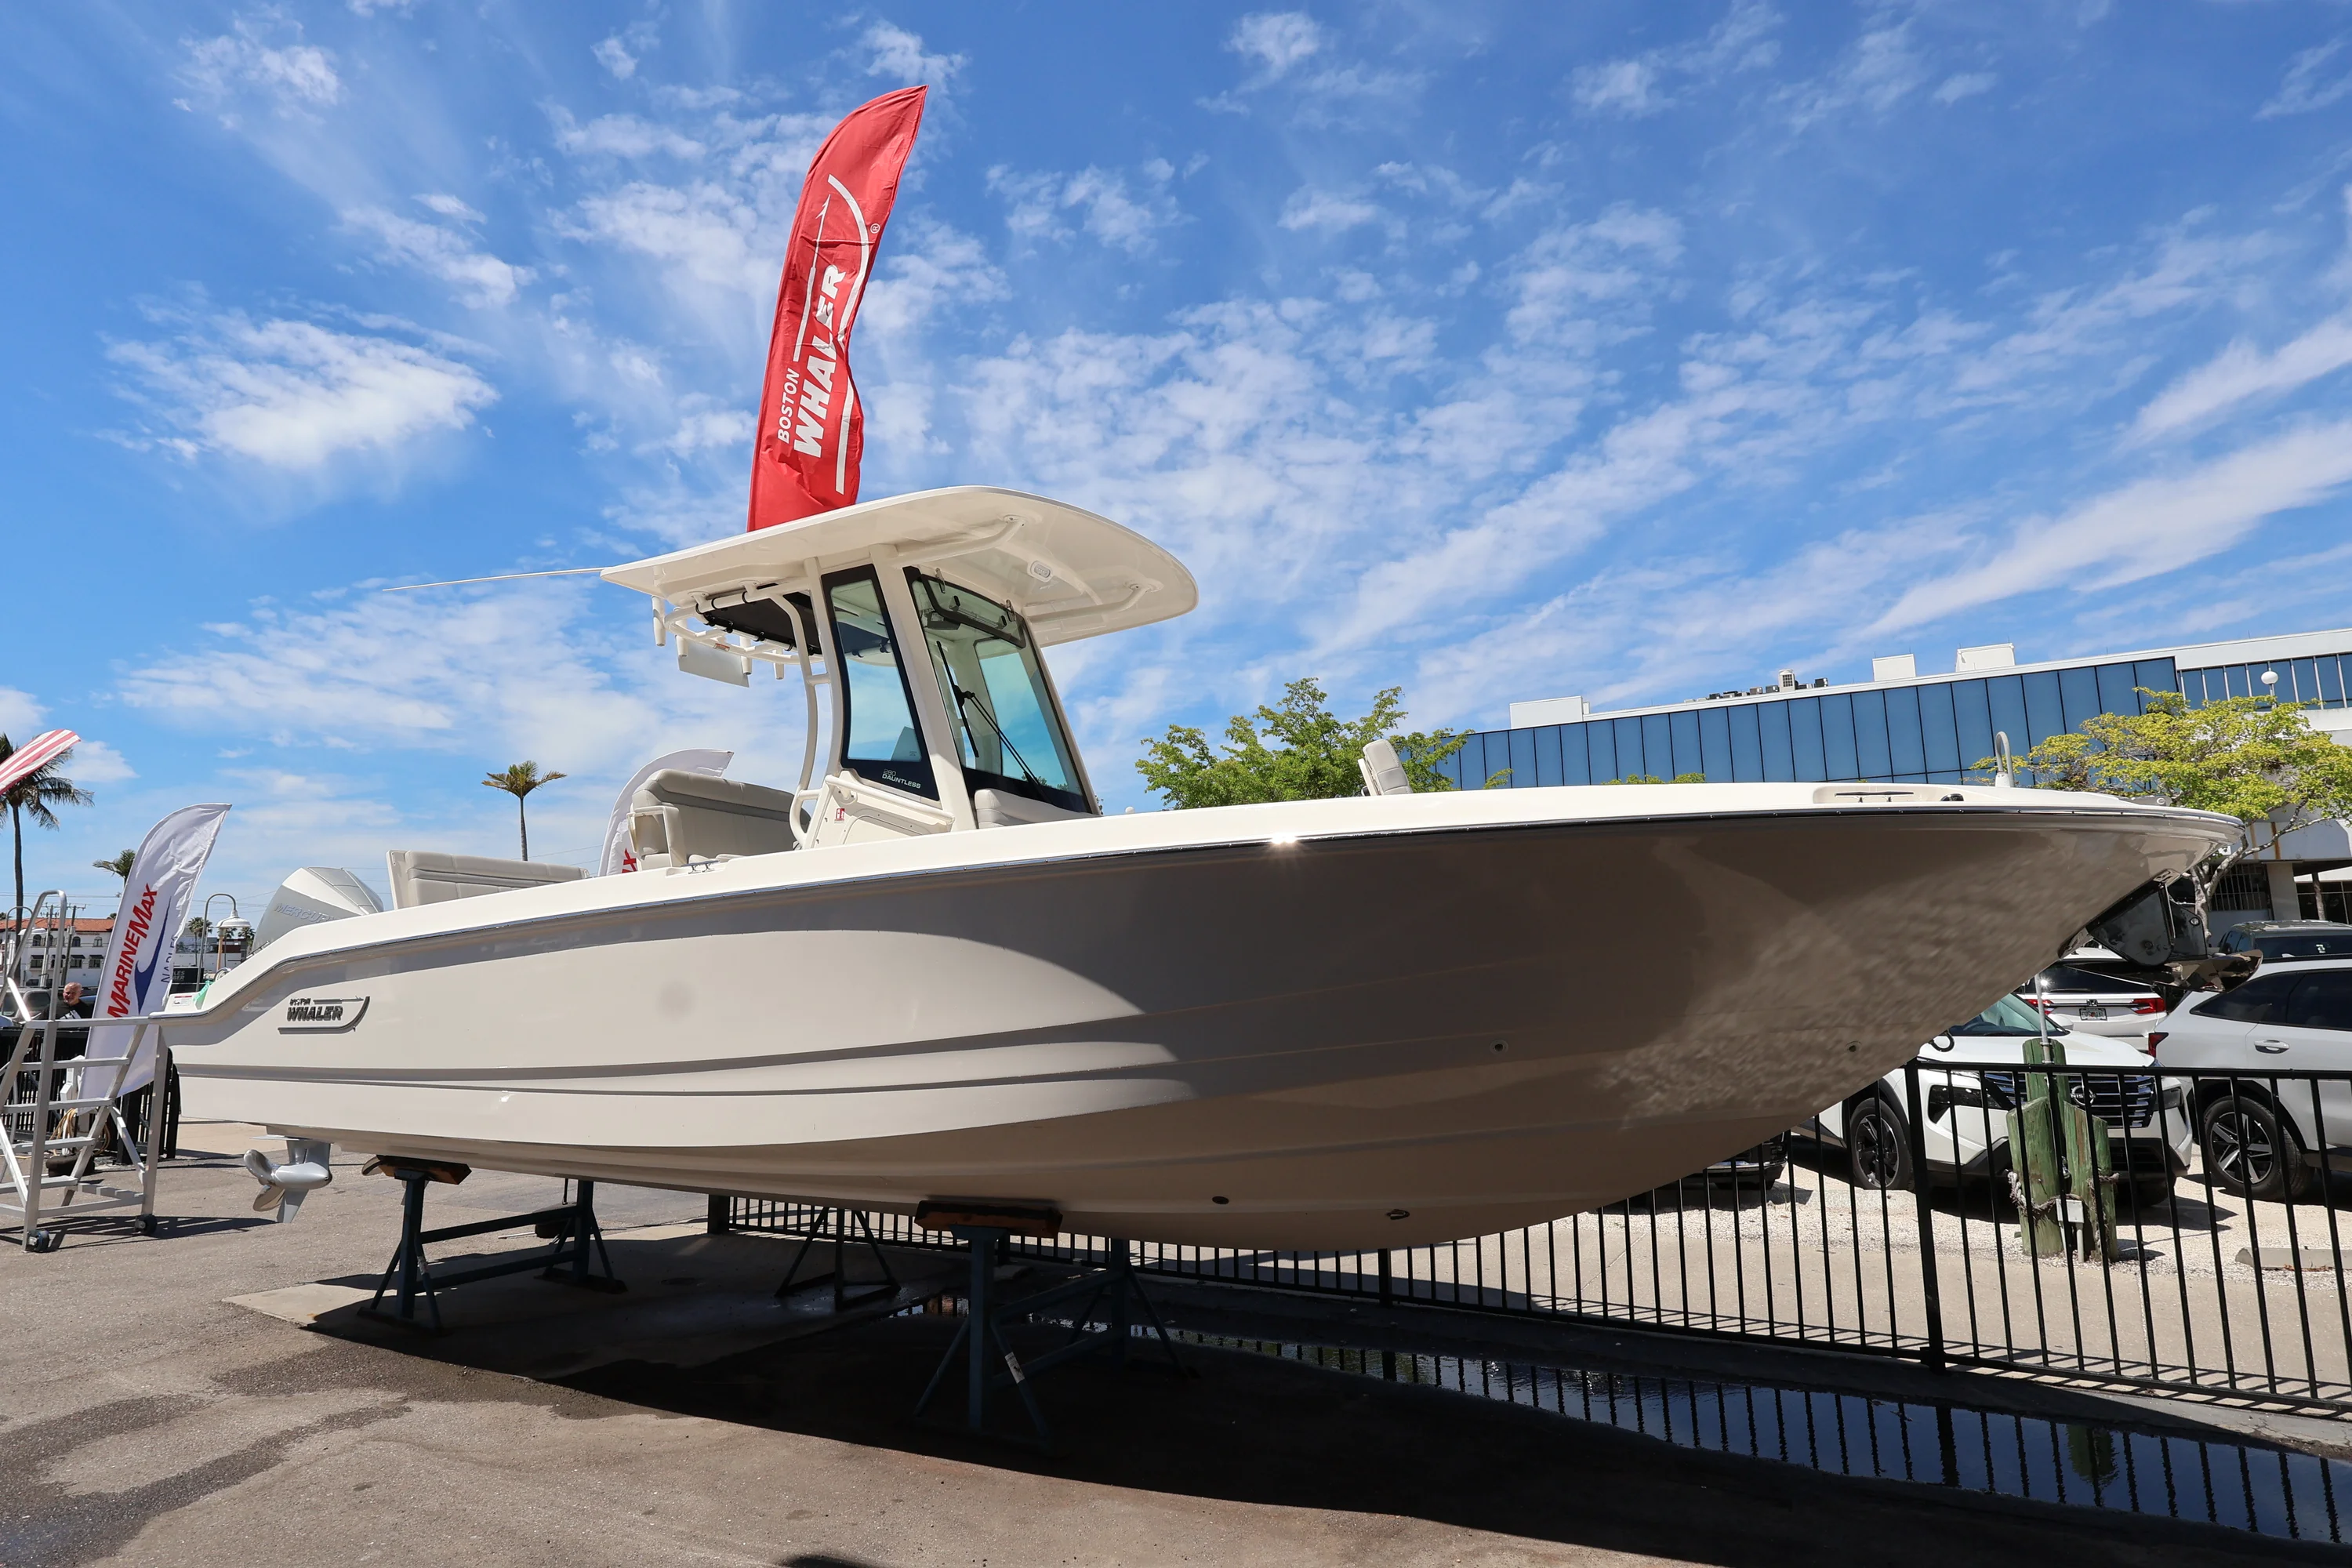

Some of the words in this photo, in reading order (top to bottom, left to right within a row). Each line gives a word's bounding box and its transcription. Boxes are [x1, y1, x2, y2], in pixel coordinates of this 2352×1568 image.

[793, 264, 847, 459] WHALER
[777, 367, 800, 444] BOSTON
[881, 773, 921, 789] DAUNTLESS
[883, 768, 897, 777] 280
[274, 903, 339, 923] MERCUR
[287, 1006, 343, 1022] WHALER
